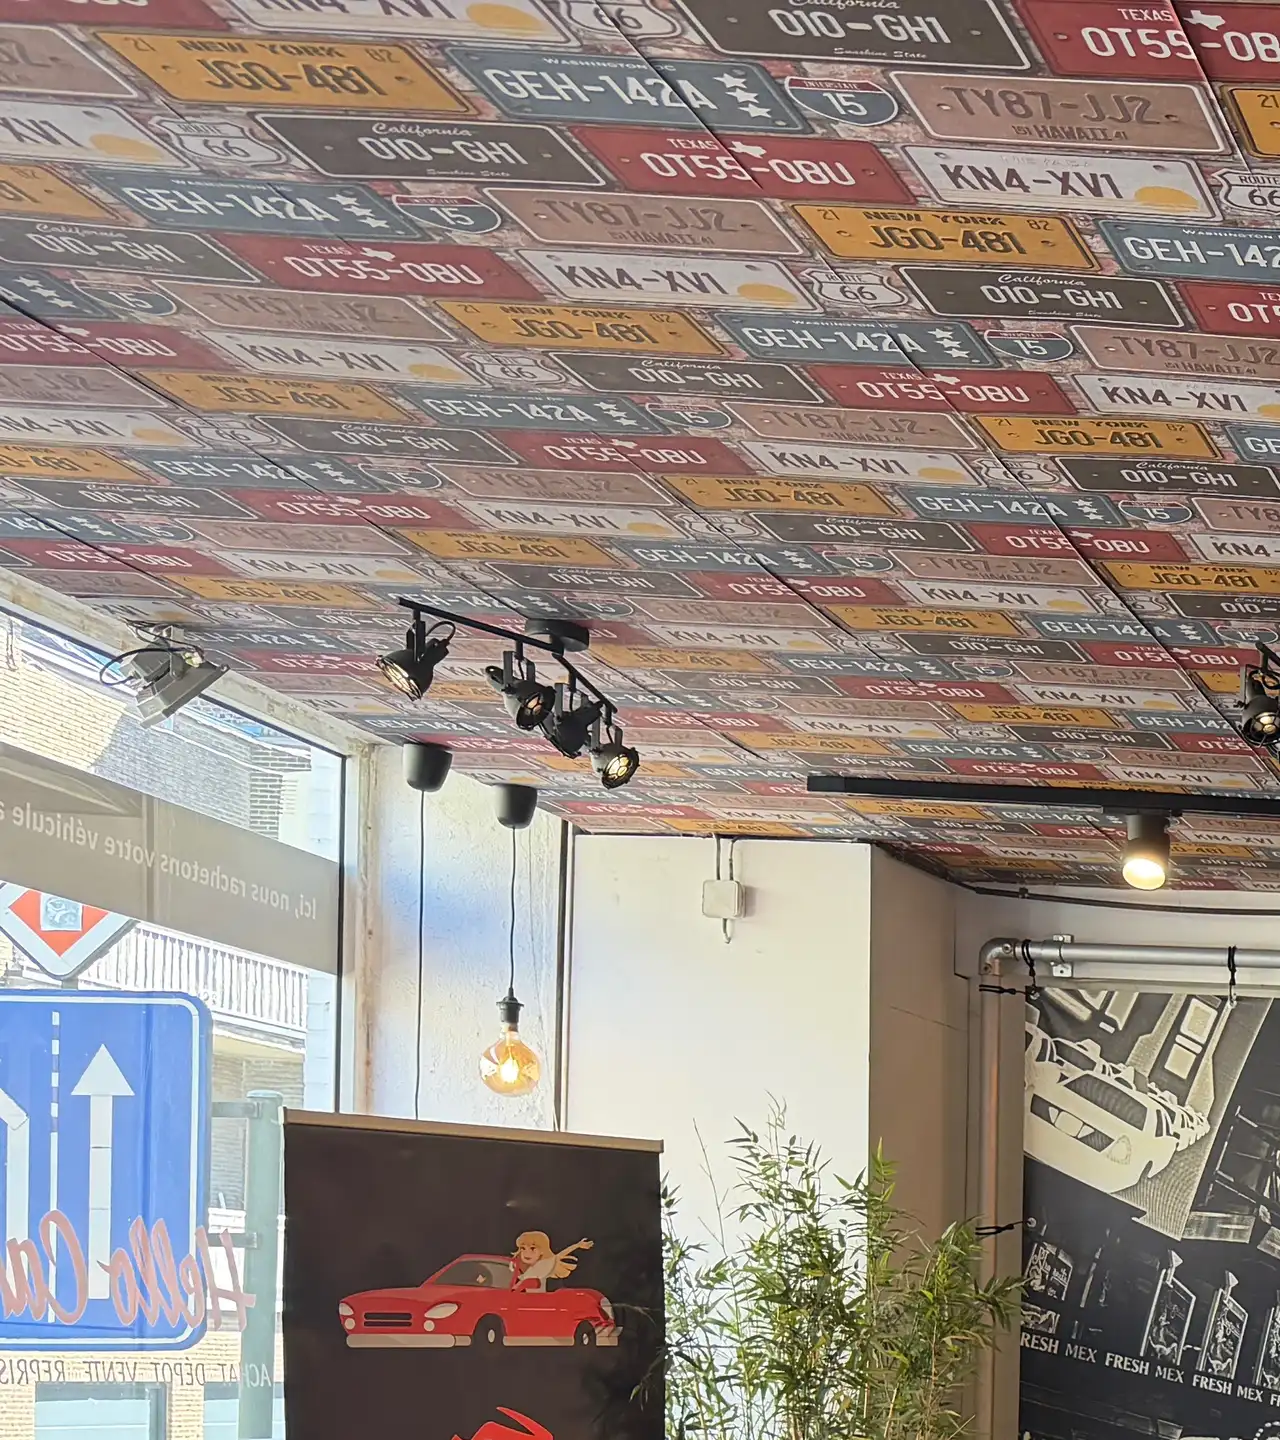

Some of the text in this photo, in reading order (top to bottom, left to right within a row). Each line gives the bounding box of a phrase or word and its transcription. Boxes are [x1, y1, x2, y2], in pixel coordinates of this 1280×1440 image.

[1117, 6, 1174, 21] TEXAS
[477, 68, 720, 109] GEH-142A
[1255, 93, 1279, 107] 21
[821, 92, 871, 116] 15
[942, 87, 1163, 126] TY87-JJ2
[1032, 125, 1113, 141] HAWAII
[191, 136, 254, 157] 66
[115, 187, 343, 221] GEH-142A
[737, 326, 929, 354] GEH-142A
[1065, 1343, 1097, 1363] MEX
[1105, 1353, 1150, 1376] FRESH
[1155, 1365, 1185, 1384] MEX
[1192, 1374, 1232, 1396] FRESH
[1237, 1385, 1263, 1402] MEX
